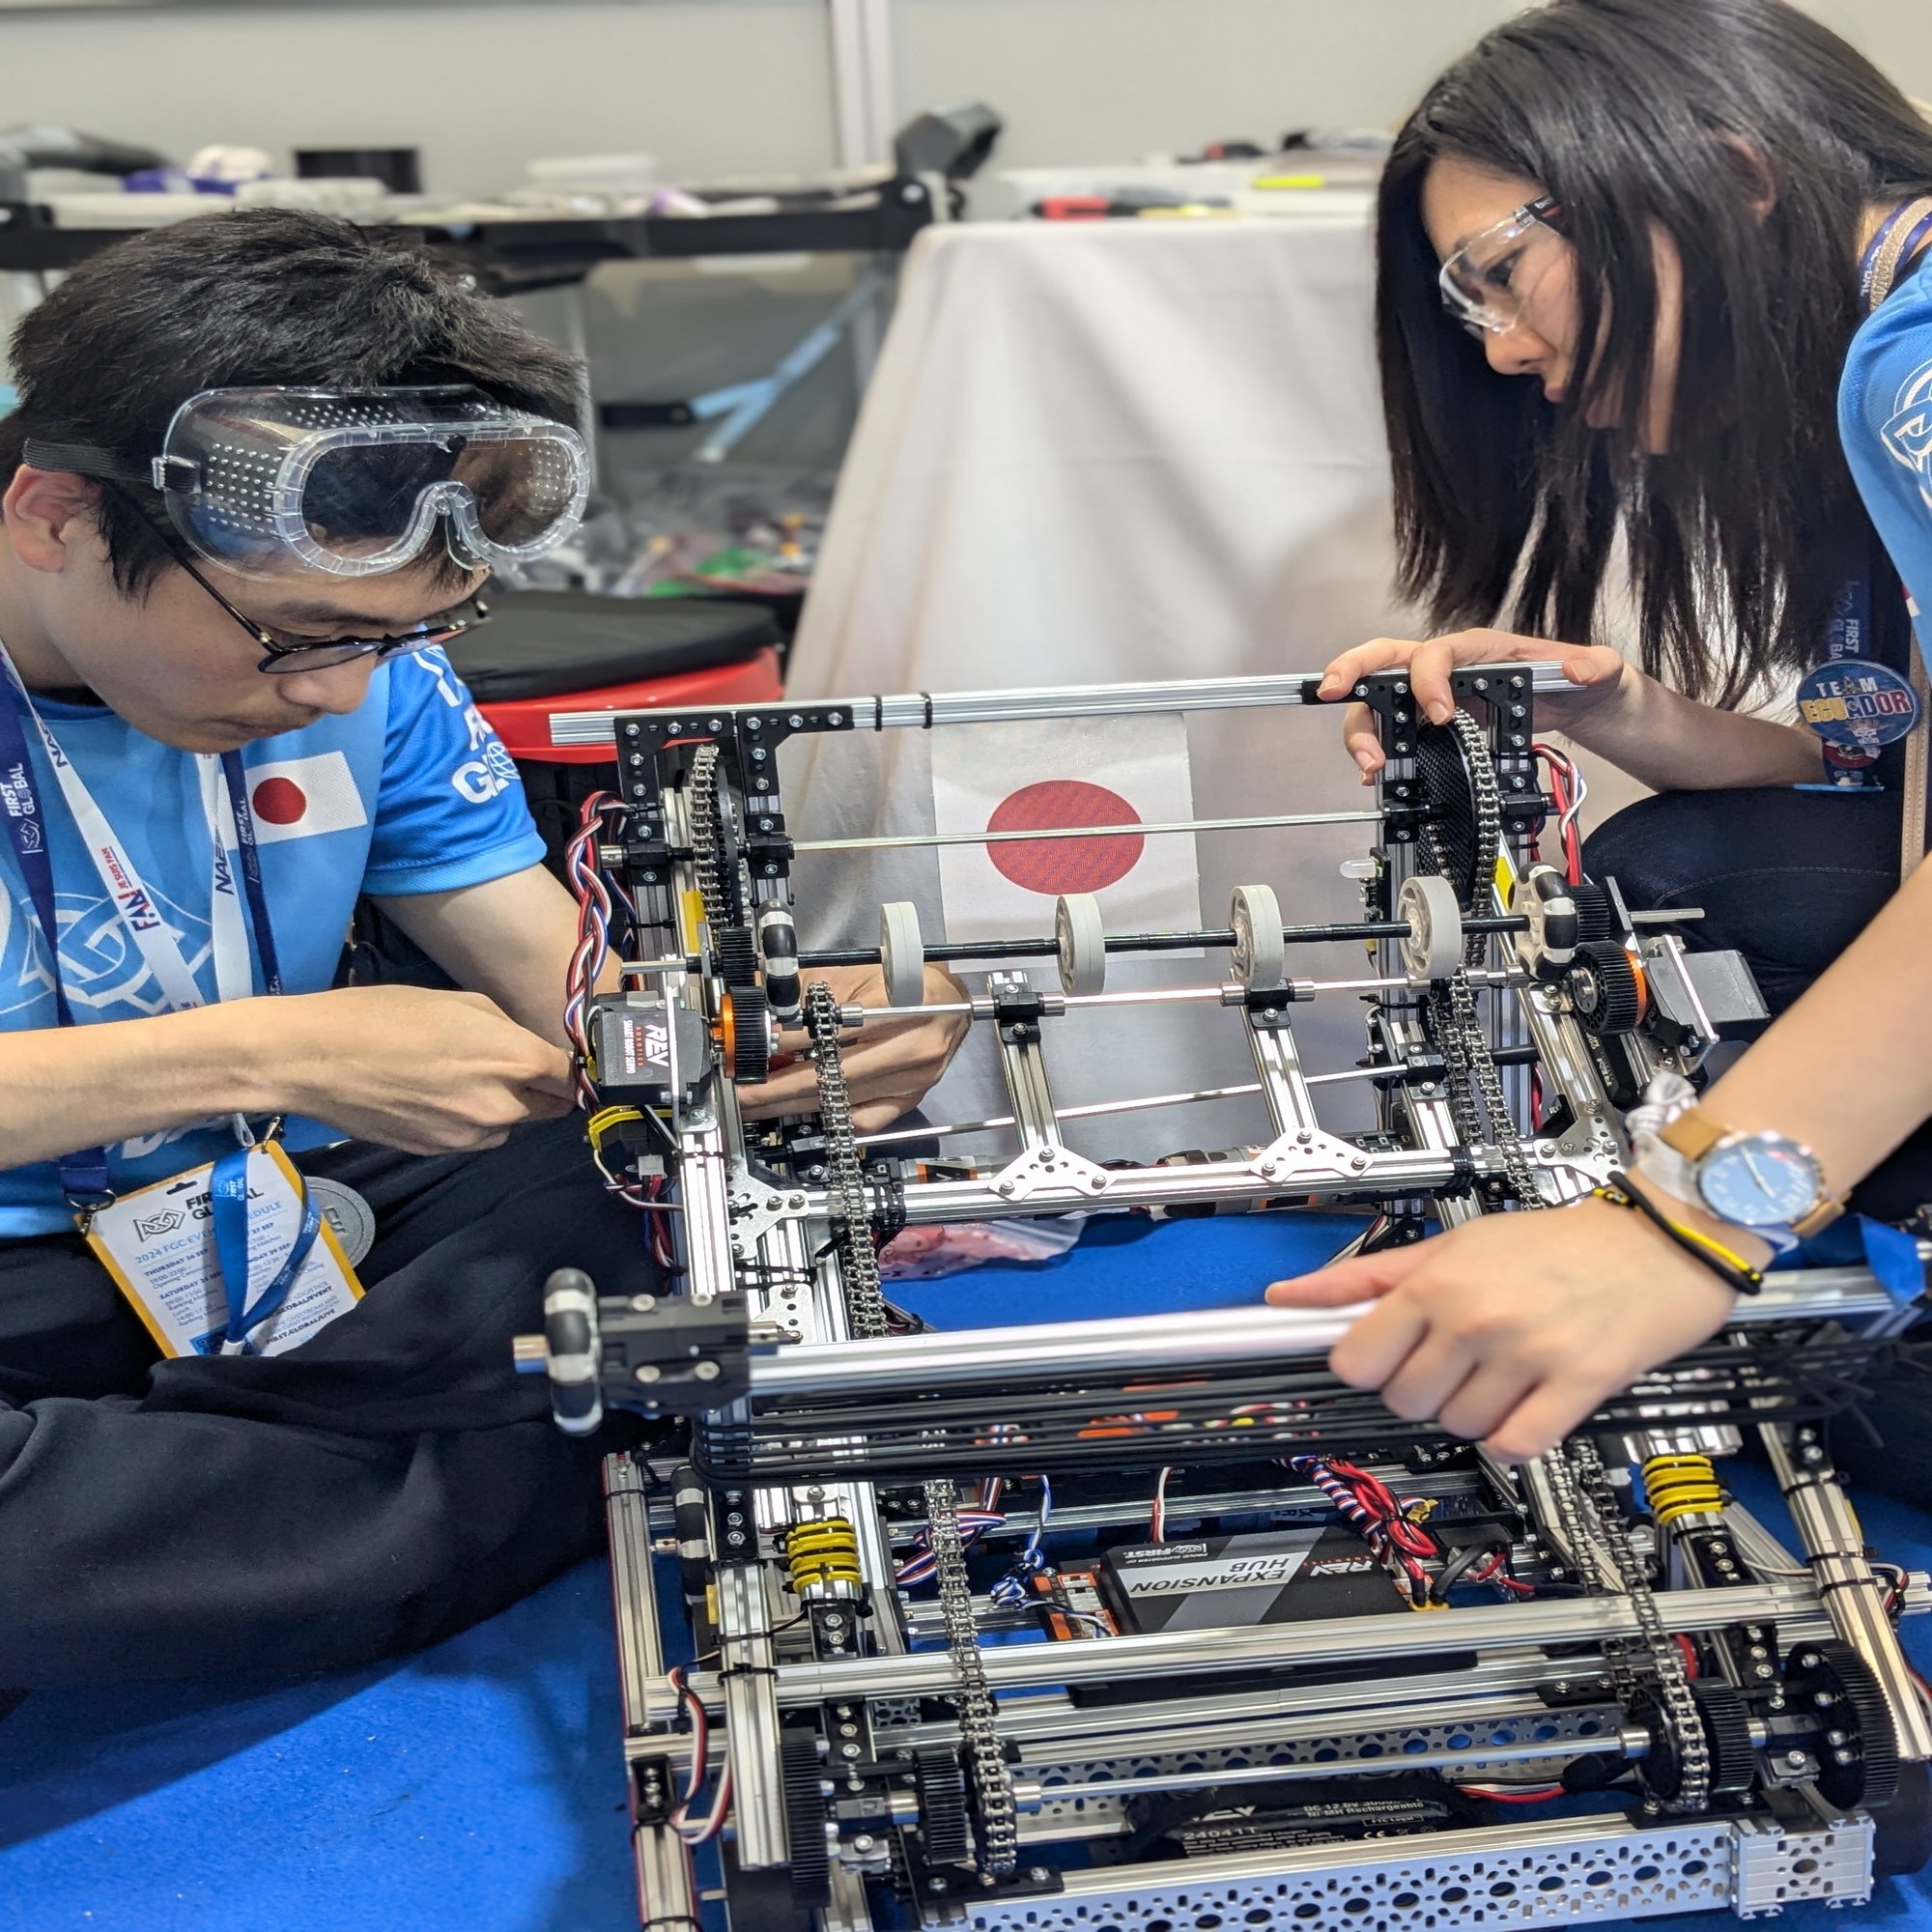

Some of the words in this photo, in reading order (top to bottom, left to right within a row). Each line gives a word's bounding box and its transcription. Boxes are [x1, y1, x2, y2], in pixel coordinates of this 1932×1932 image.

[1829, 619, 1845, 661] GLOBA
[1845, 619, 1860, 653] FIRST
[1816, 676, 1879, 697] TEAM
[1800, 690, 1912, 724] ECUADOR
[0, 782, 22, 817] FIRST
[8, 763, 36, 815] GLOBAL
[623, 1020, 634, 1038] SMART
[624, 1038, 635, 1056] ROBOT
[636, 1026, 644, 1066] ROBOTICS
[645, 1024, 669, 1067] REV
[626, 1056, 637, 1074] SERVO
[185, 1191, 213, 1210] FIR
[135, 1248, 162, 1264] 2024
[163, 1239, 186, 1253] FGC
[187, 1229, 214, 1244] EVEN
[144, 1258, 185, 1276] THURSDAY
[196, 1248, 209, 1257] SEP
[159, 1281, 199, 1300] SATURDAY
[1230, 1557, 1290, 1573] HUB
[1310, 1560, 1373, 1577] REV
[1130, 1569, 1286, 1592] EXPANSION
[1347, 1802, 1424, 1814] Rechargeable
[1182, 1826, 1259, 1840] 24041T
